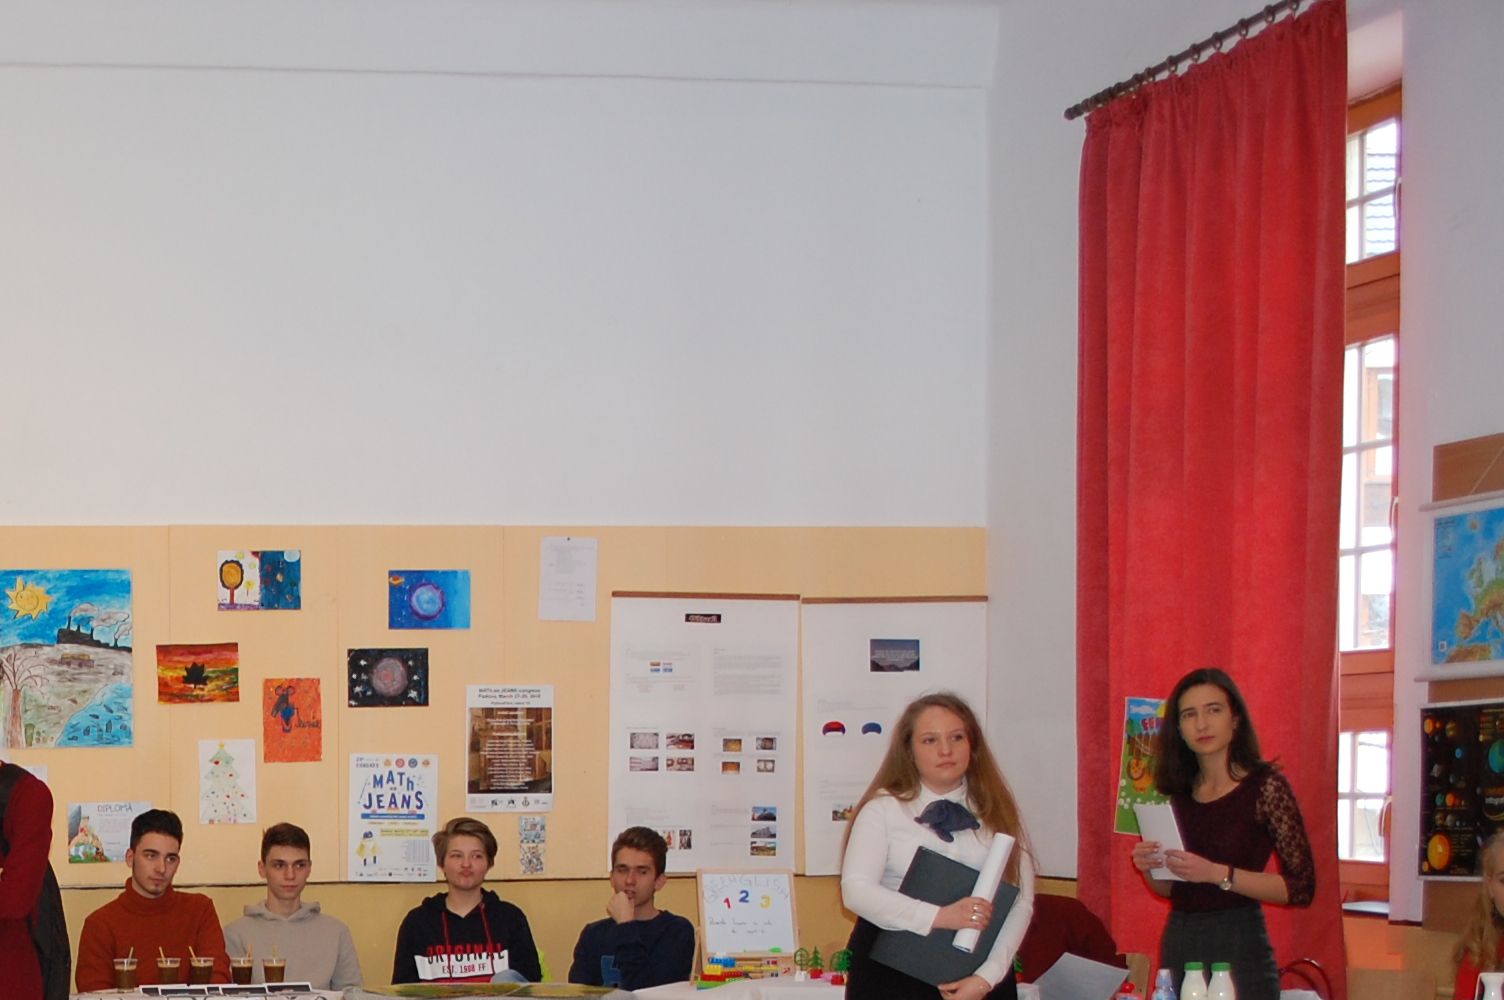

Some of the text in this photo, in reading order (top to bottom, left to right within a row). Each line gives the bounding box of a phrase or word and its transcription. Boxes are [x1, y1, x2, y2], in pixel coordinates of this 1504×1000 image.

[373, 770, 415, 791] MATh
[363, 791, 424, 809] JEANS
[723, 890, 771, 909] 1 2 3
